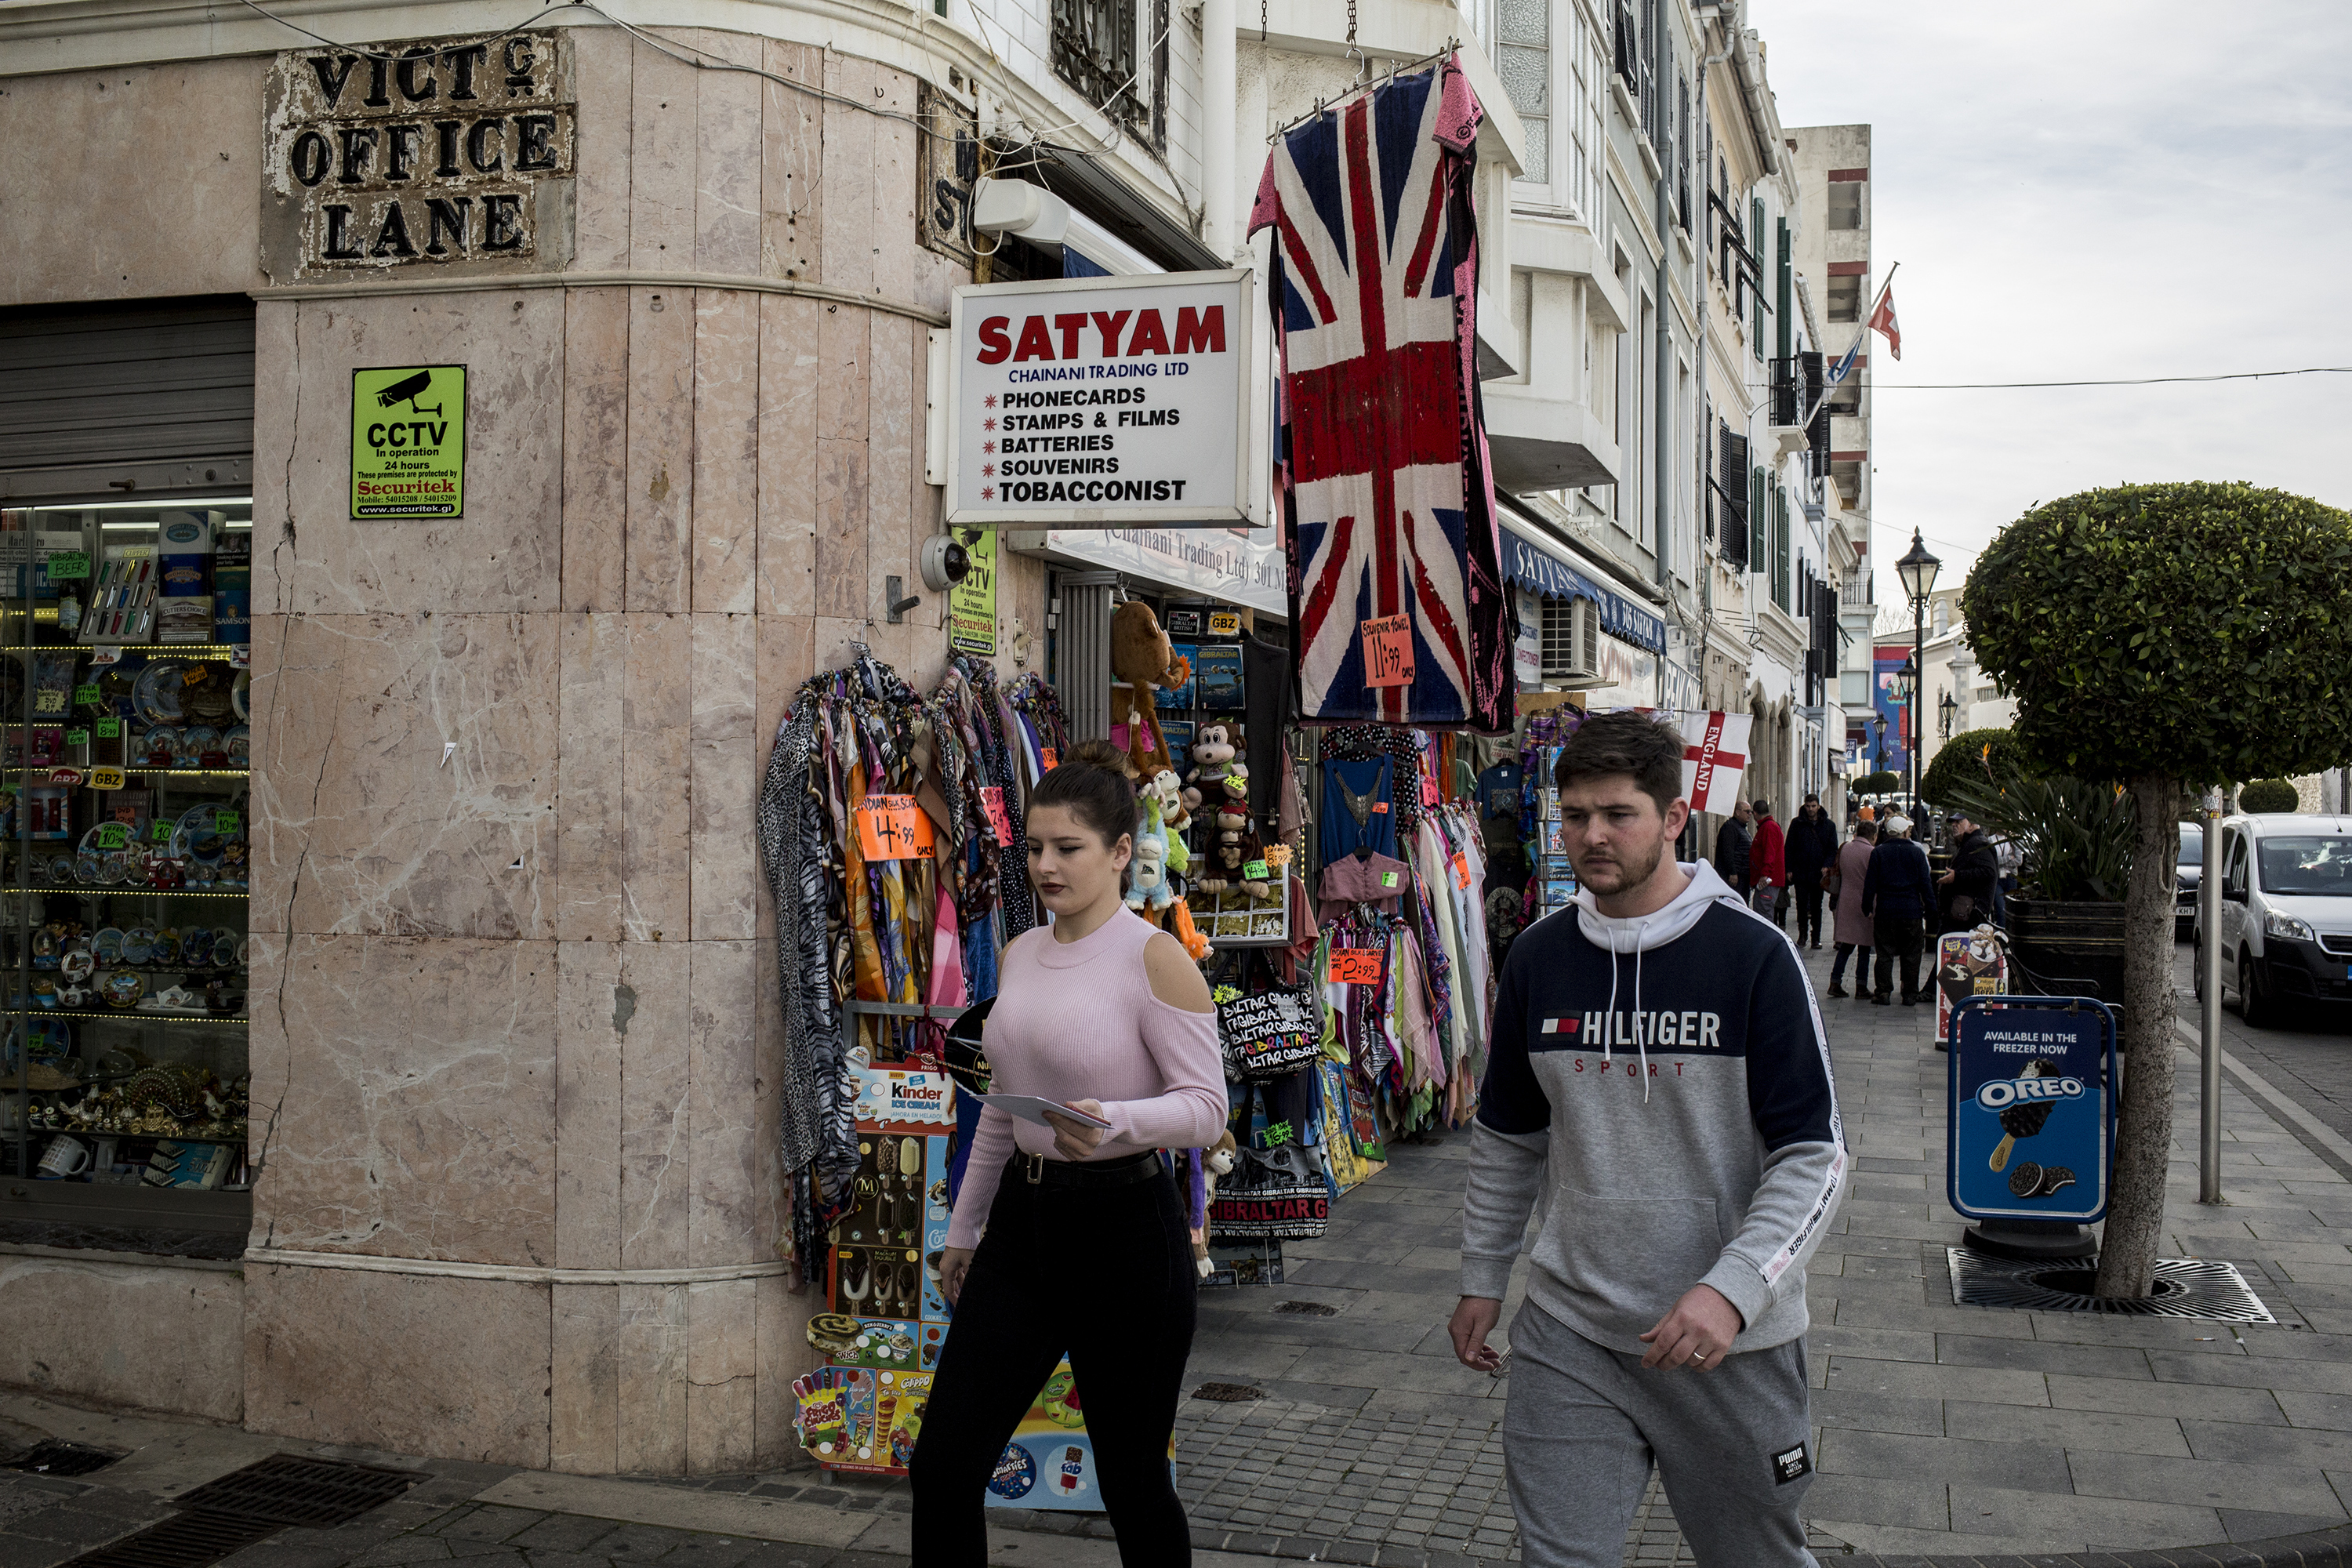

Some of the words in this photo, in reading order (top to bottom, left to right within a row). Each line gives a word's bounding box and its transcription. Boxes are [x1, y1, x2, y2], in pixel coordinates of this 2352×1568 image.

[307, 45, 488, 111] VICT
[291, 114, 557, 187] OFFICE
[321, 194, 525, 260] LANE
[976, 305, 1227, 365] SATYAM
[1008, 366, 1085, 383] CHAINANI
[1089, 363, 1158, 379] TRADING
[1164, 362, 1189, 376] LTD
[1003, 387, 1145, 408] PHONECARDS
[1002, 412, 1083, 431] STAMPS
[1093, 412, 1107, 428] &
[1117, 408, 1180, 427] FILMS
[368, 421, 448, 448] CCTV
[1000, 434, 1114, 454] BATTERIES
[376, 448, 386, 457] In
[389, 448, 439, 459] operation
[384, 461, 397, 470] 24
[401, 461, 430, 470] hours
[1000, 457, 1120, 477] SOUVENIRS
[377, 471, 405, 480] premises
[418, 470, 448, 479] protected
[450, 470, 457, 478] by
[358, 479, 456, 495] Securitek
[999, 480, 1186, 503] TOBACCONIST
[361, 504, 452, 514] www.securitek.gi
[49, 554, 90, 562] GIBRALTAR
[1175, 532, 1223, 579] Trading
[1225, 550, 1249, 586] Ltd)
[1254, 561, 1272, 587] 301
[54, 561, 87, 576] BEER
[959, 565, 990, 590] CTV
[966, 588, 987, 599] operation
[162, 606, 187, 615] CUTTERS
[187, 606, 207, 615] CHOICE
[964, 598, 971, 607] 24
[971, 600, 983, 610] hours
[215, 617, 251, 626] SAMSON
[953, 614, 993, 633] Securitek
[1212, 618, 1236, 629] GBZ
[1363, 622, 1390, 638] SOUVENIR
[1402, 665, 1414, 679] ONLY
[1160, 727, 1190, 735] RALTAR
[1697, 726, 1721, 791] ENGLAND
[95, 773, 120, 785] GBZ
[876, 815, 914, 853] 4:99
[916, 845, 933, 856] ONLY
[1267, 854, 1288, 865] 8:99
[1331, 949, 1350, 957] INDIAN
[1343, 958, 1375, 980] 2:99
[1582, 1011, 1720, 1047] HILFIGER
[1984, 1031, 2038, 1043] AVAILABLE
[2042, 1032, 2053, 1043] IN
[2056, 1033, 2077, 1044] THE
[1245, 1033, 1312, 1055] GIBRALTAR
[1993, 1043, 2037, 1054] FREEZER
[2039, 1044, 2067, 1054] NOW
[1575, 1059, 1685, 1077] SPORT
[891, 1082, 943, 1100] Kinder
[1980, 1076, 2082, 1107] OREO
[891, 1100, 906, 1109] ICE
[907, 1101, 941, 1110] CREAM
[860, 1179, 874, 1192] M
[1262, 1187, 1295, 1196] GIBRALTAR
[1820, 1174, 1838, 1212] TOMMY
[1210, 1200, 1310, 1221] GIBRALTAR
[1788, 1218, 1815, 1256] HILFIGER
[1769, 1250, 1791, 1280] SPORT
[805, 1401, 836, 1418] FRIGO
[1778, 1446, 1803, 1466] PUMA
[1061, 1463, 1082, 1475] fab
